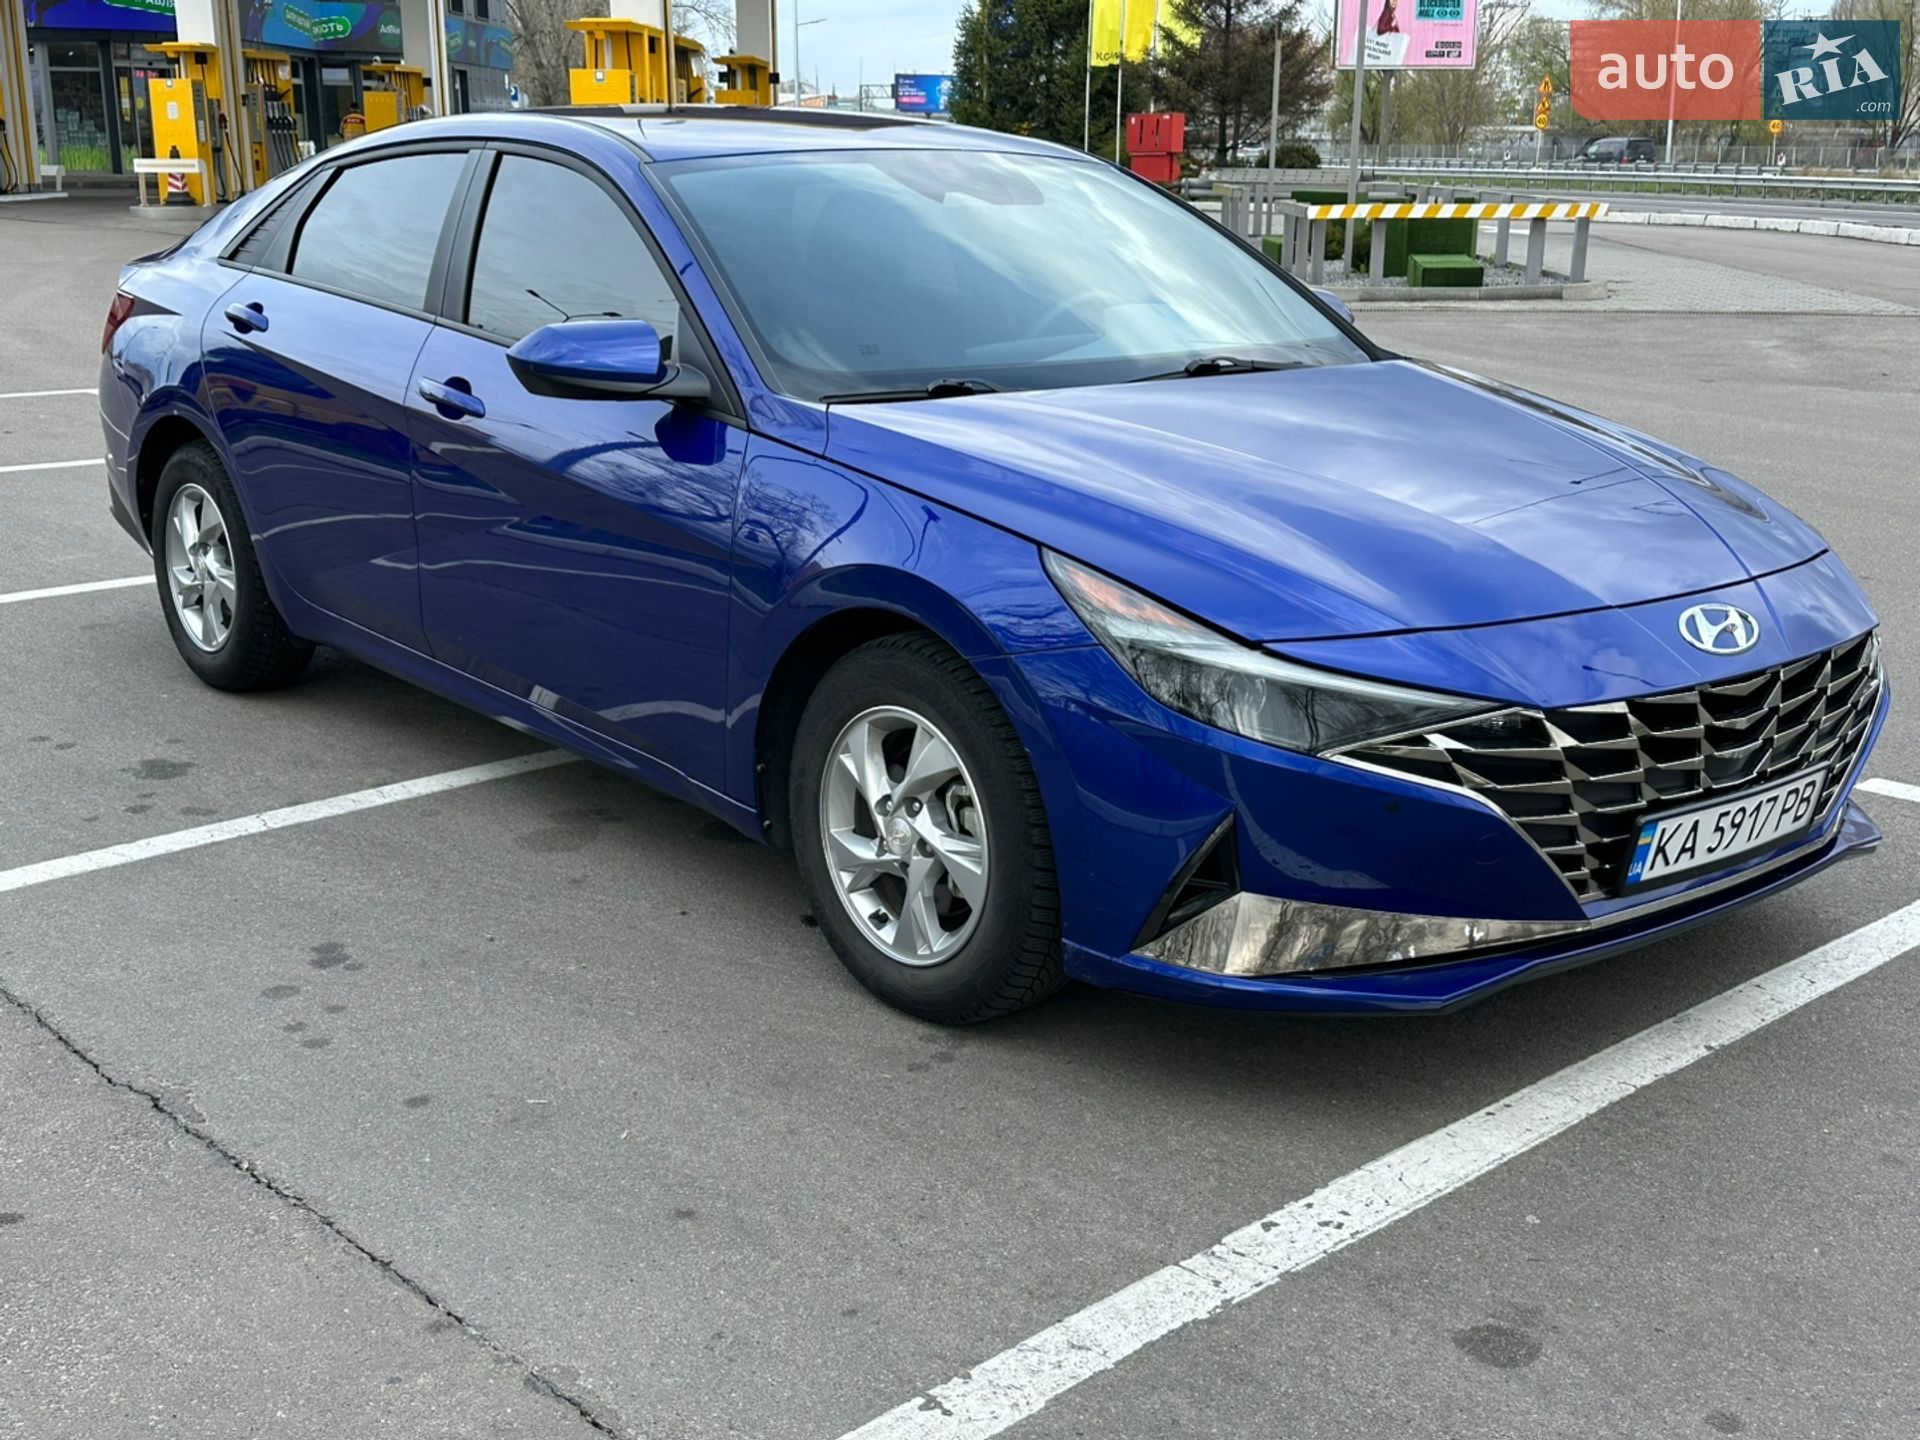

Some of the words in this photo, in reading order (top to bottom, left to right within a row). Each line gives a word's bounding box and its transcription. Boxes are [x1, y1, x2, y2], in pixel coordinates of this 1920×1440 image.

[1648, 819, 1700, 871] KA
[1706, 794, 1780, 854] 5917
[1774, 779, 1817, 832] PB
[1628, 861, 1642, 877] UA
